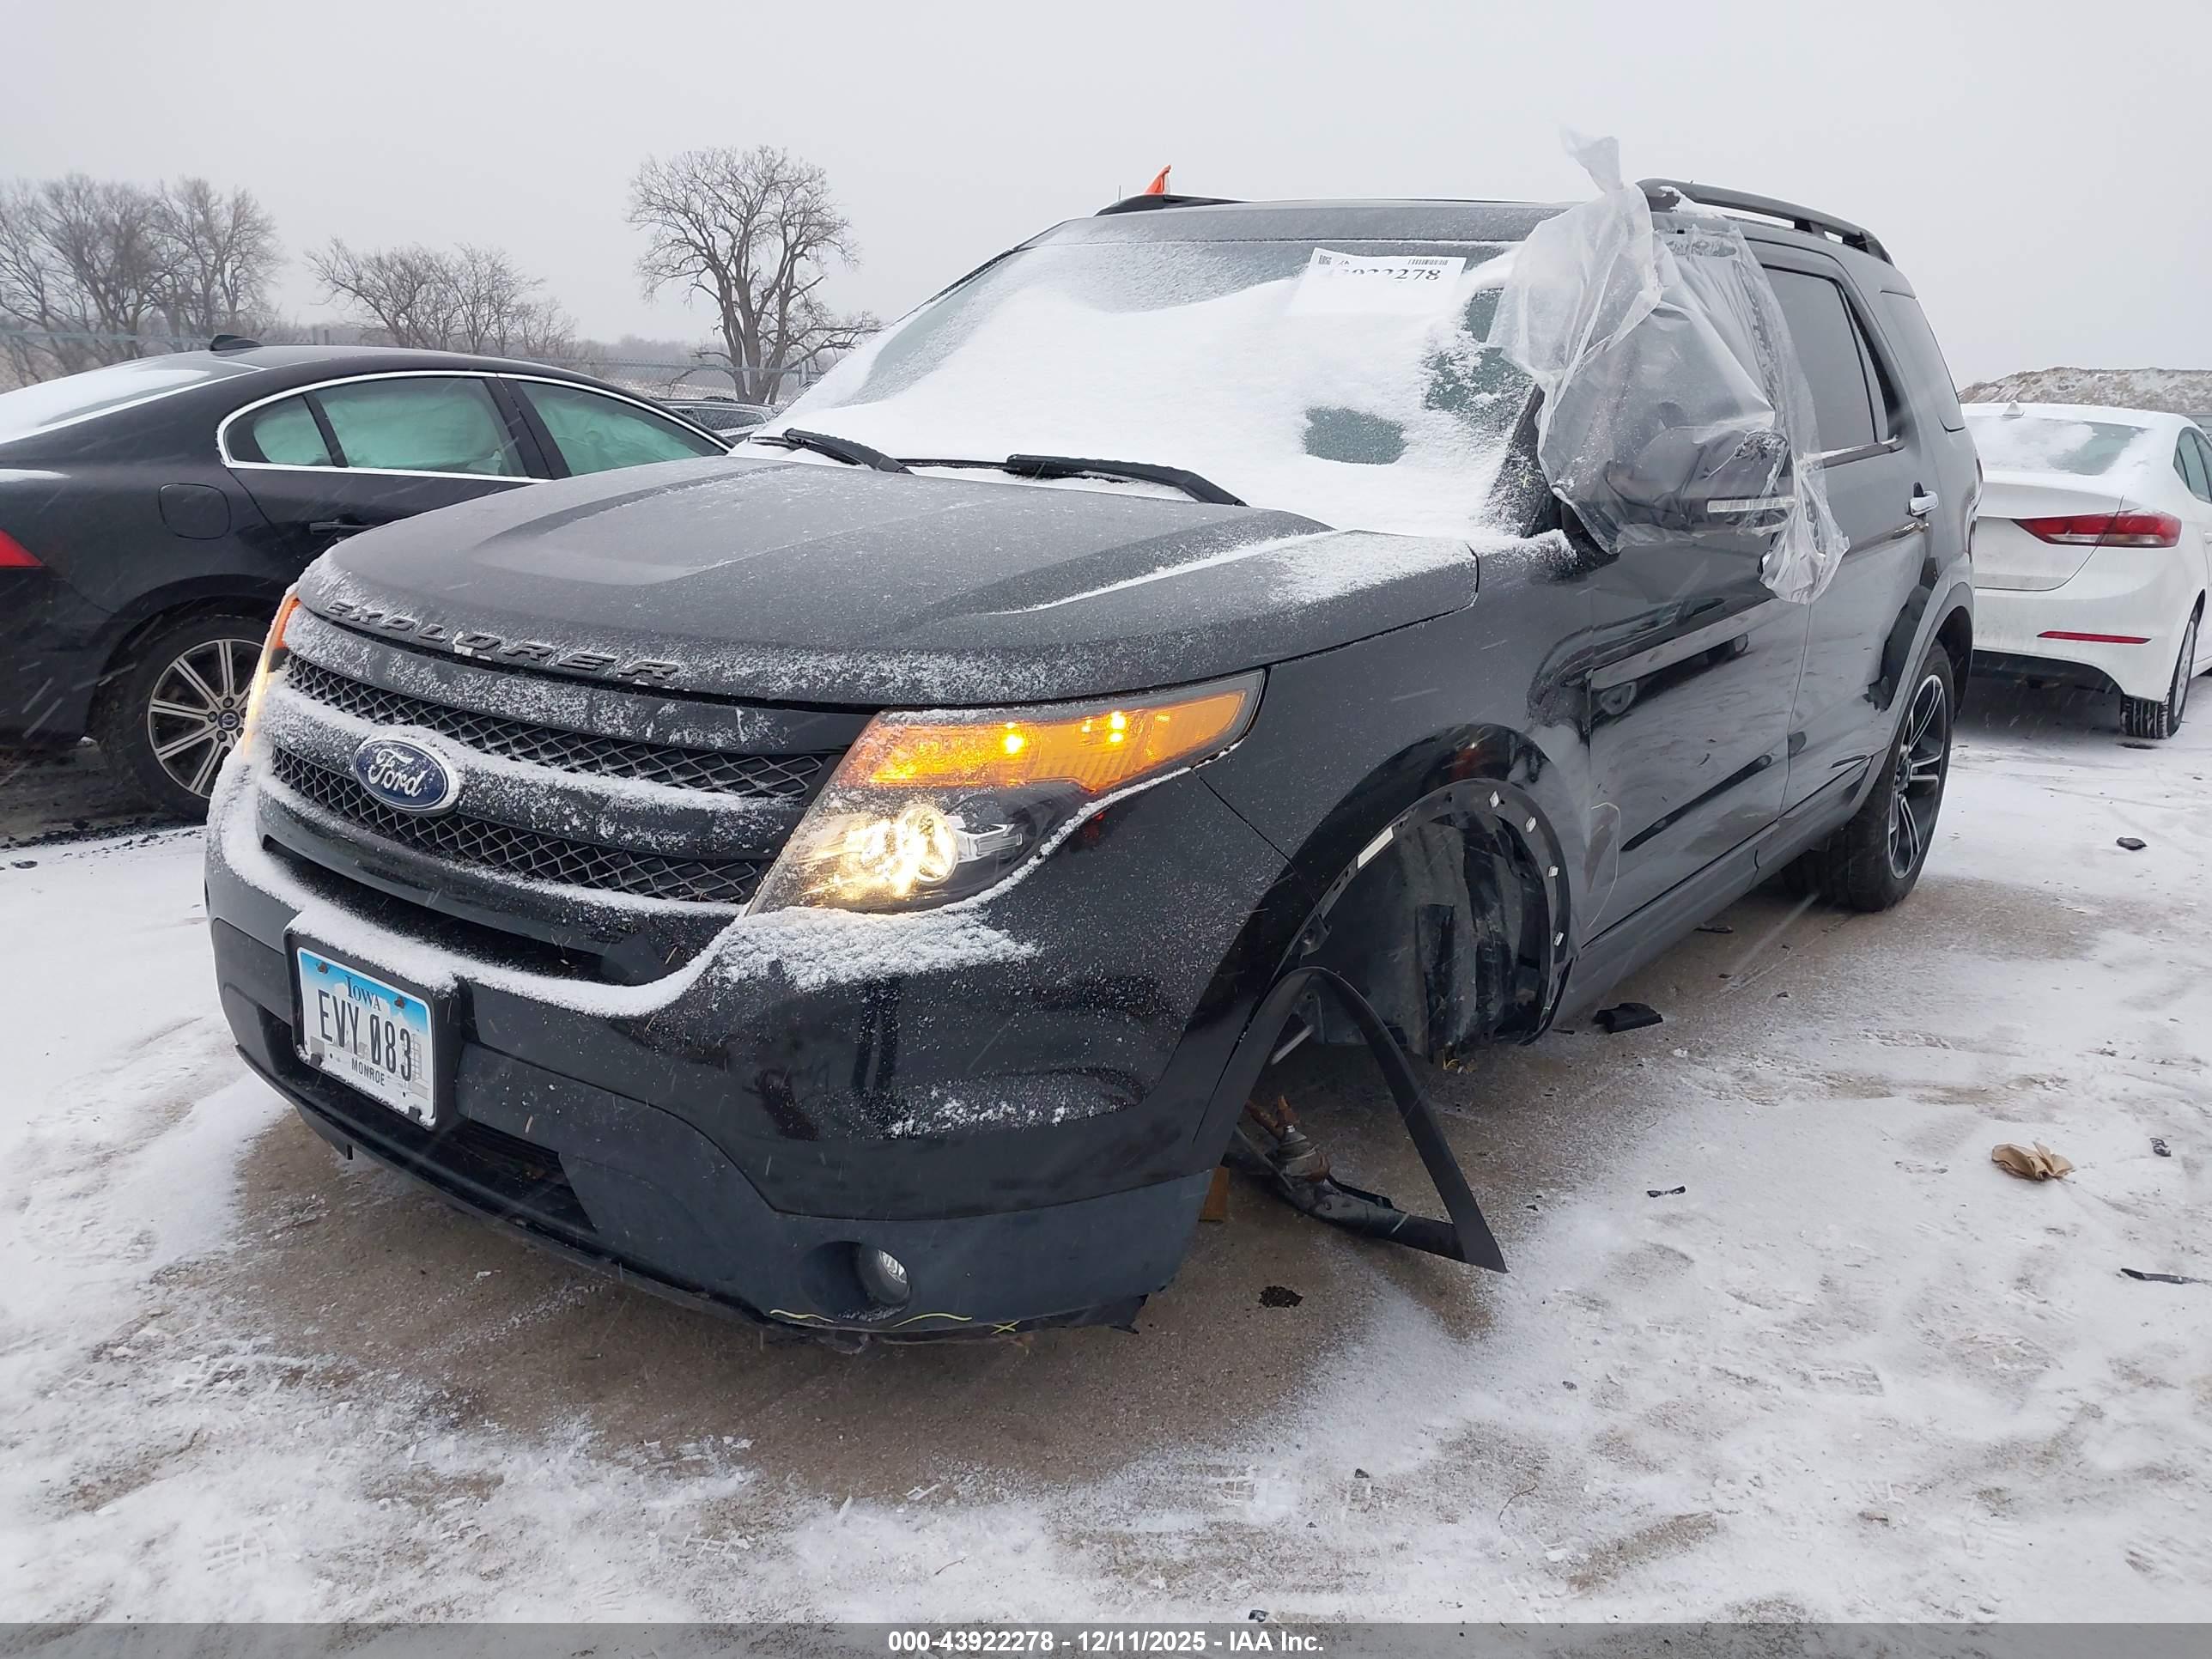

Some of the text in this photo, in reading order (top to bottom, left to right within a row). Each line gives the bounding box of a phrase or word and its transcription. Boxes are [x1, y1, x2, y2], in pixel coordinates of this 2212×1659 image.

[325, 601, 679, 680] EXPLORER
[368, 748, 429, 798] Ford
[344, 975, 381, 1012] IOWA
[318, 988, 411, 1082] EVY 083
[351, 1057, 385, 1086] MONROE
